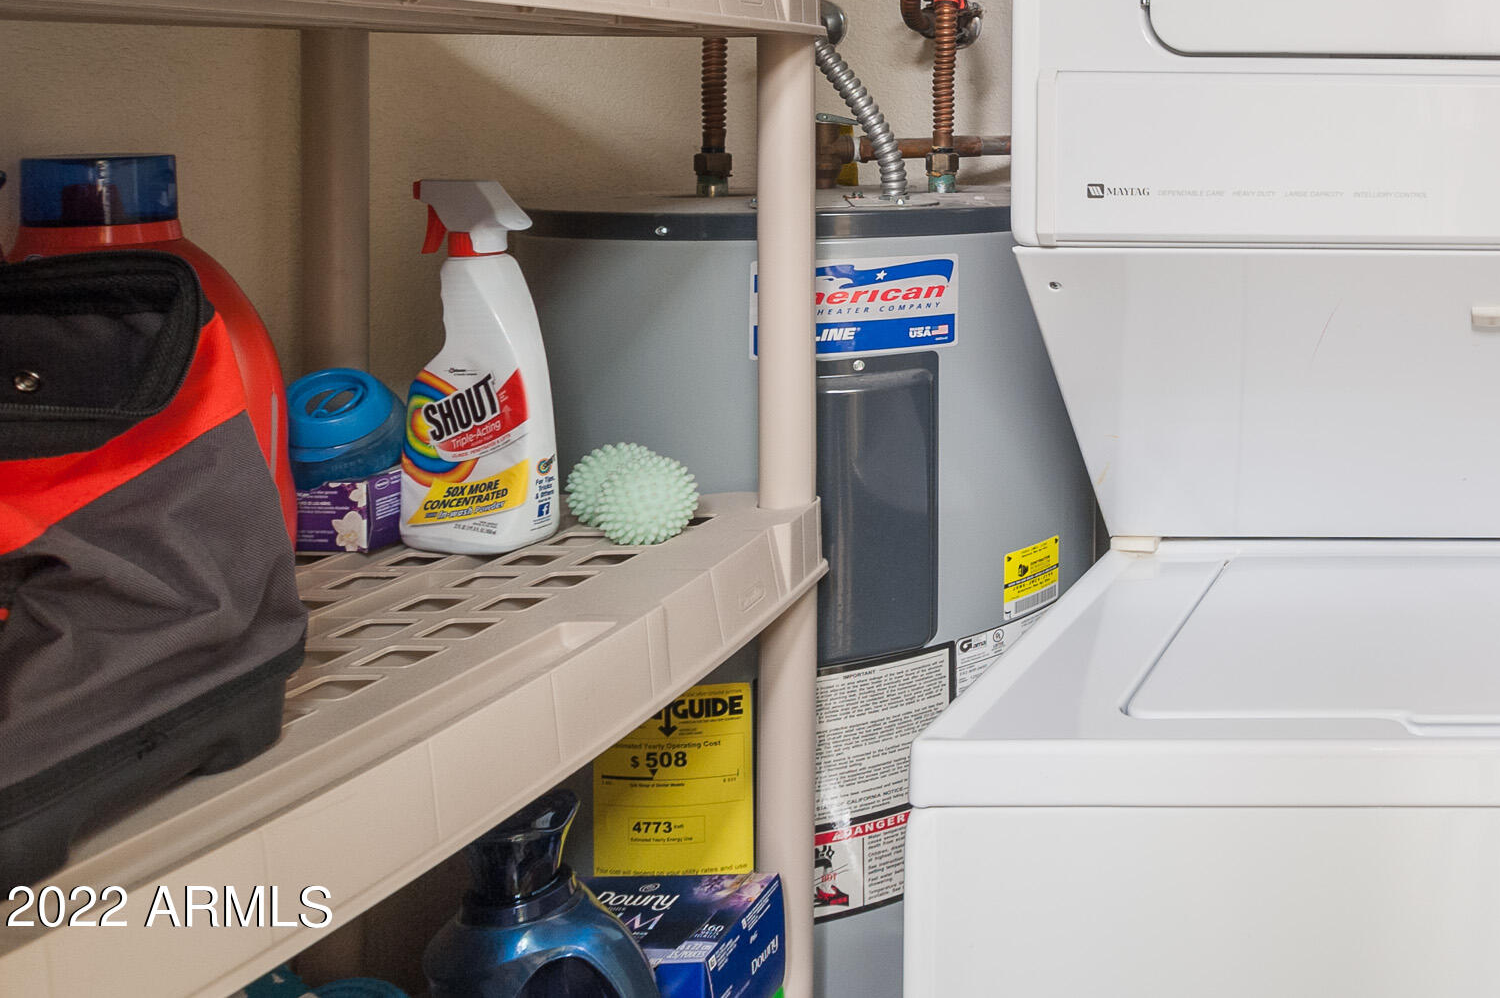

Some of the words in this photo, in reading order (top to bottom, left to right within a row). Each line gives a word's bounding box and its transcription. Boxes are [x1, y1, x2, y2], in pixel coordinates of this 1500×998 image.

[1106, 186, 1150, 196] MAYTAG
[817, 307, 869, 316] HEATER
[880, 302, 941, 313] COMPANY
[816, 327, 855, 342] INE
[909, 329, 931, 338] USA
[424, 373, 498, 441] SHOUT
[451, 420, 501, 448] Triple-Acting
[443, 483, 468, 498] 50X
[468, 479, 500, 495] MORE
[423, 488, 508, 510] CONCENTRATED
[842, 670, 876, 680] IMPORTANT
[672, 695, 743, 719] GUIDE
[644, 742, 664, 751] Yearly
[667, 741, 701, 750] Operating
[630, 755, 639, 768] $
[646, 751, 687, 768] 508
[632, 821, 673, 834] 4773
[846, 814, 905, 838] DANGER
[597, 891, 680, 910] Downy
[752, 935, 779, 975] Downy
